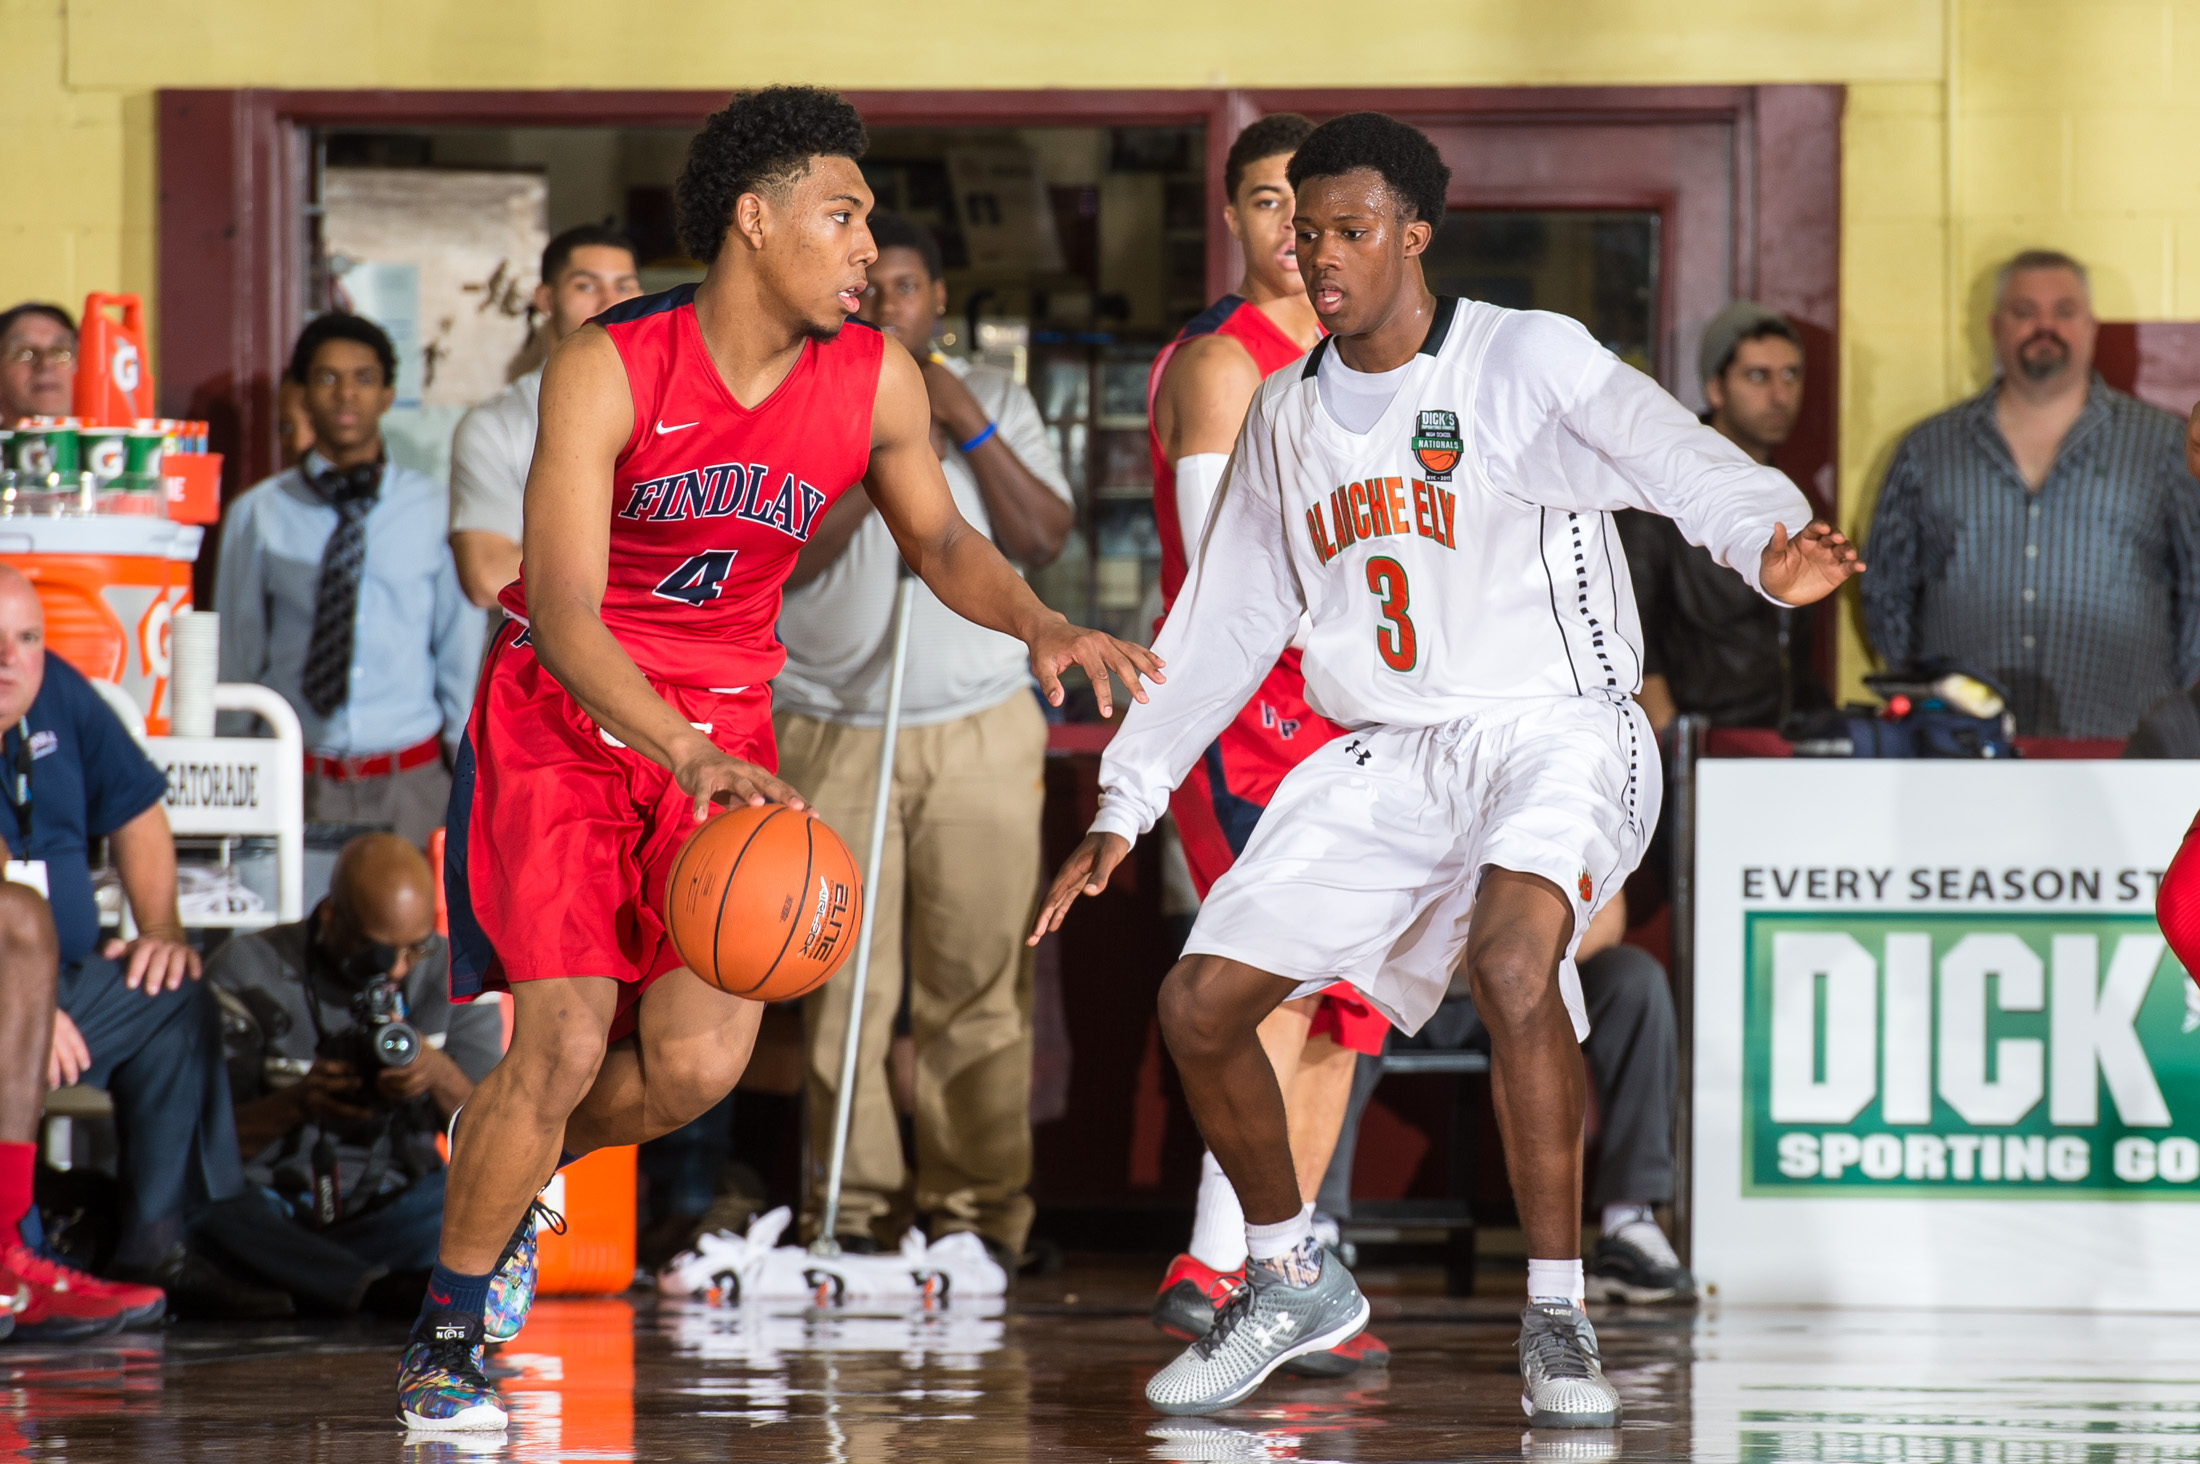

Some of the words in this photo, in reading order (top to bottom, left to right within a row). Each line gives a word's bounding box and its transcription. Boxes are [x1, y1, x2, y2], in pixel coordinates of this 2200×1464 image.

[1418, 439, 1458, 449] NATIONALS
[1422, 411, 1455, 426] DICK'S
[88, 439, 124, 479] G
[618, 462, 826, 542] FINDLAY
[1411, 478, 1456, 550] ELY
[652, 549, 738, 607] 4
[1366, 555, 1417, 672] 3
[164, 761, 259, 807] GATORADE
[1742, 867, 1893, 900] EVERY
[1909, 869, 2101, 903] SEASON
[814, 882, 849, 963] ELITE
[1777, 1132, 2090, 1181] SPORTING
[2112, 1137, 2200, 1183] GO
